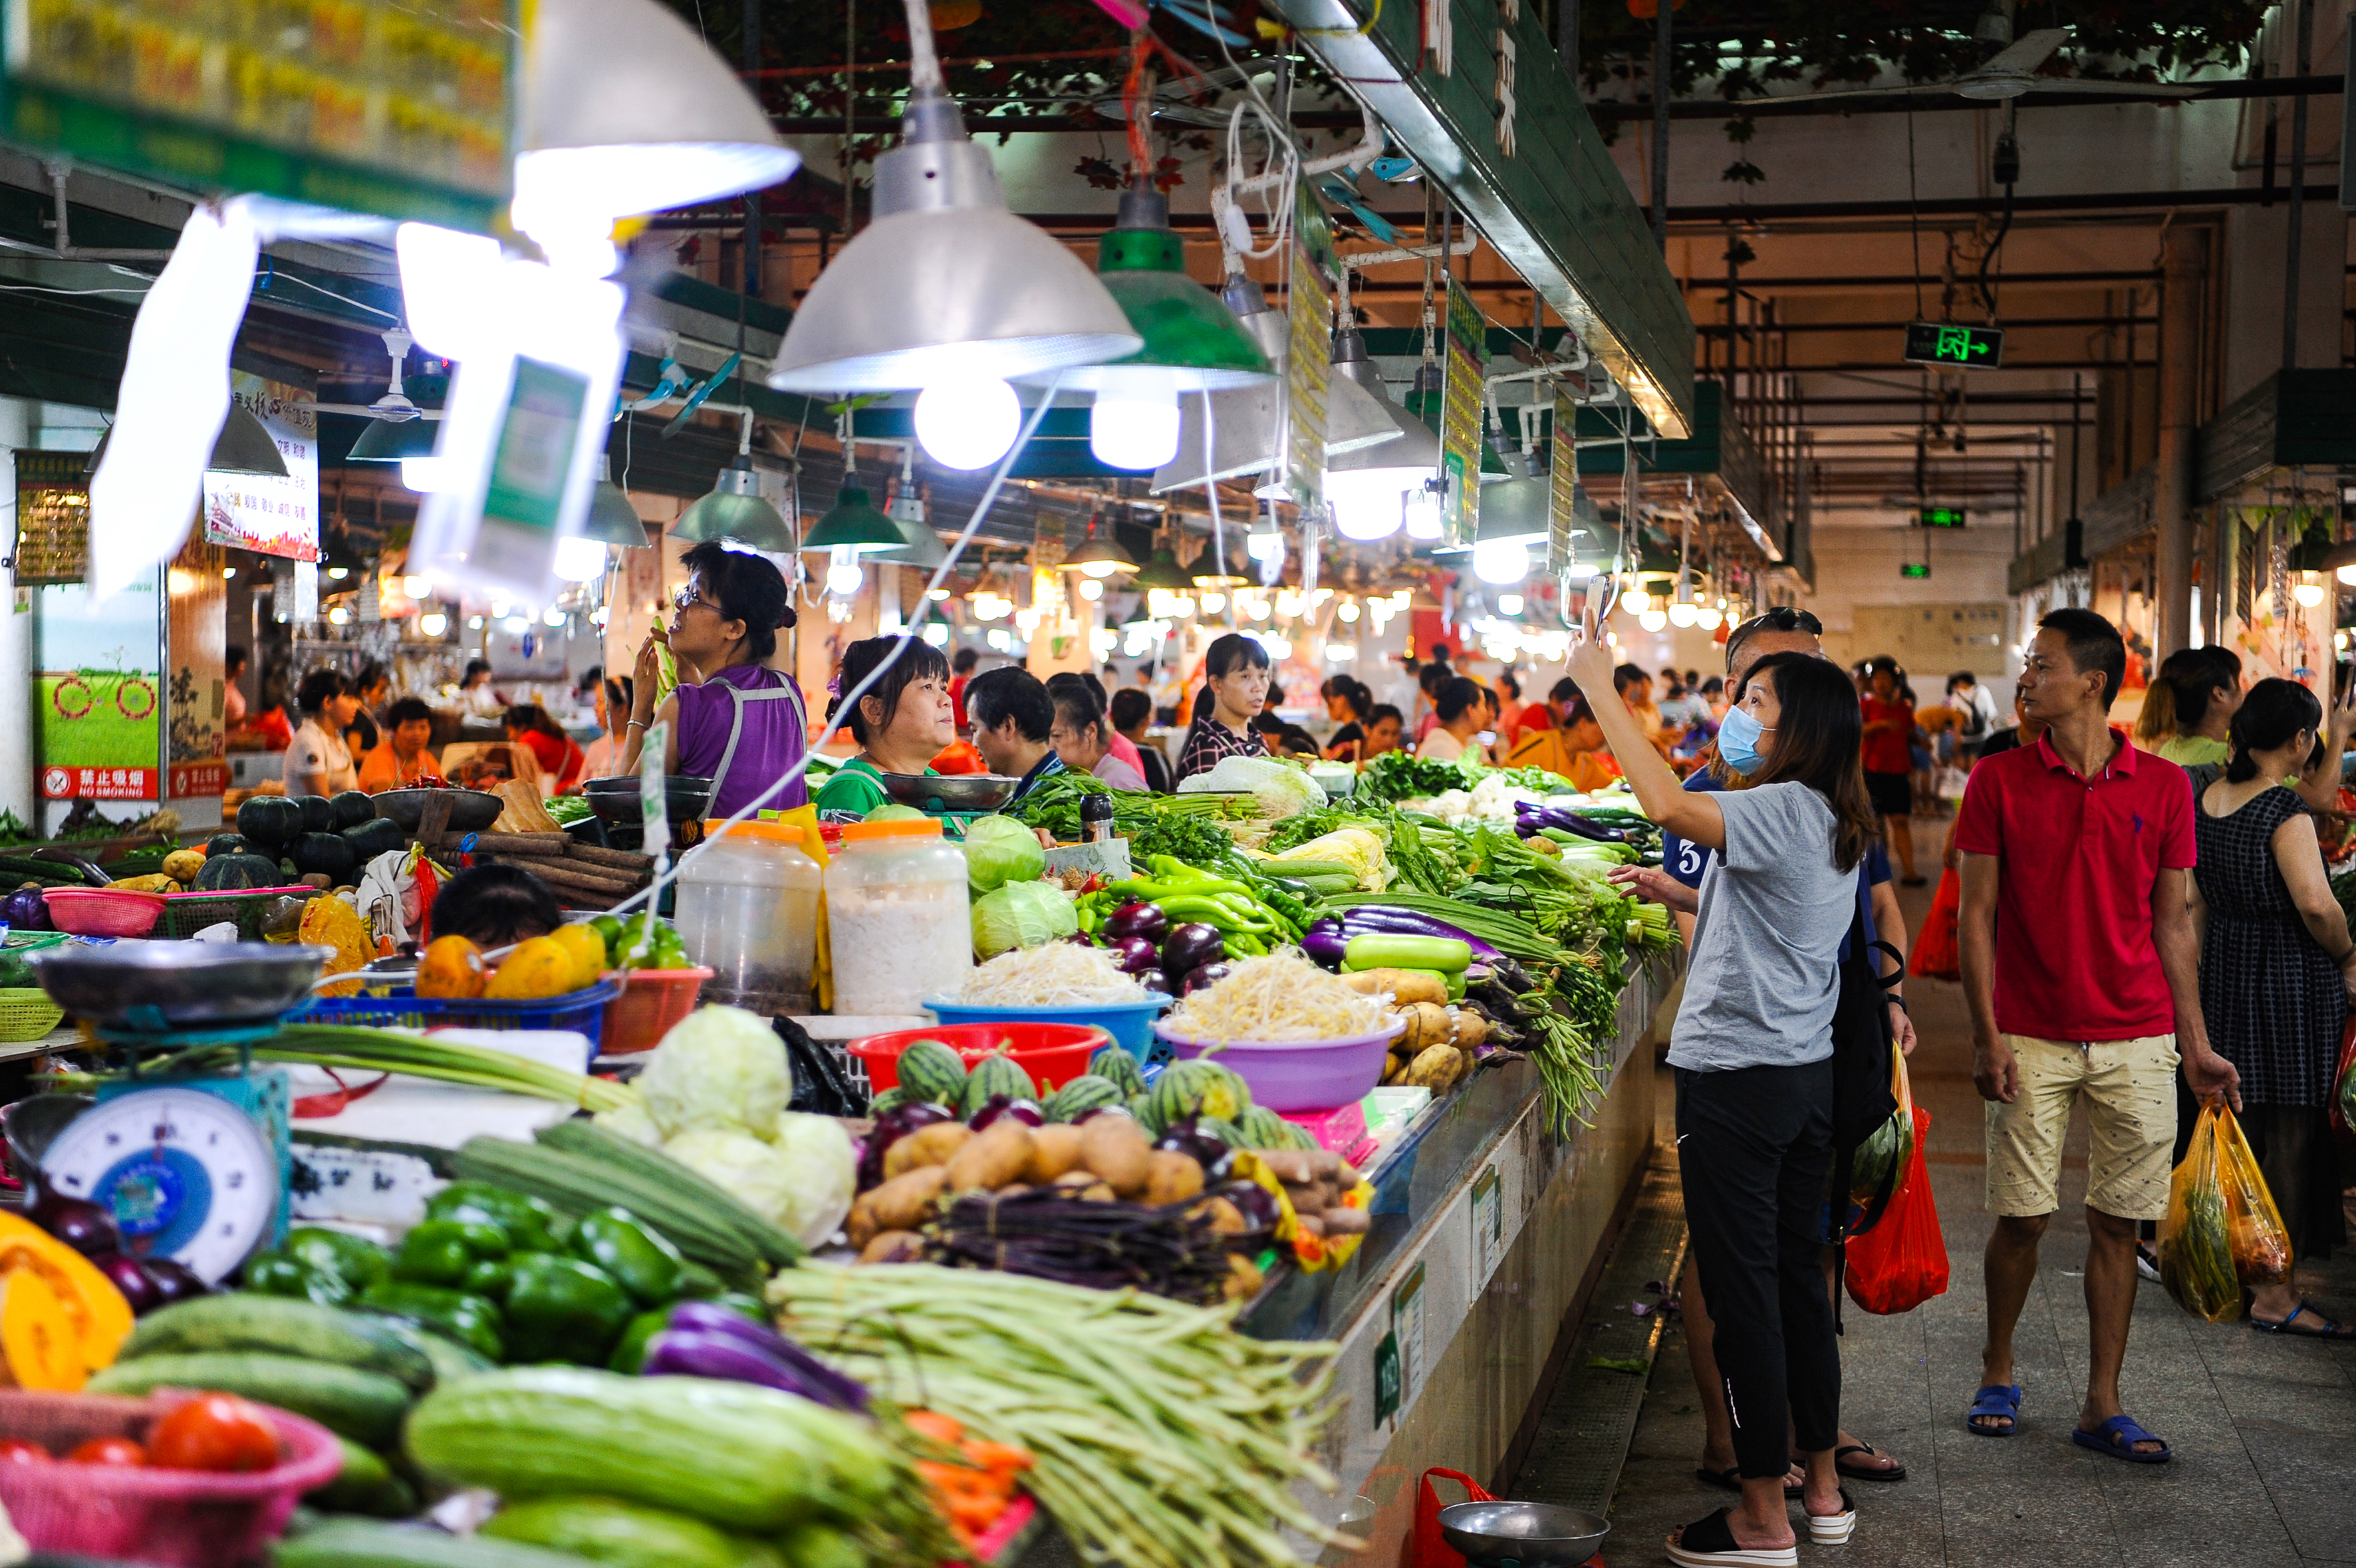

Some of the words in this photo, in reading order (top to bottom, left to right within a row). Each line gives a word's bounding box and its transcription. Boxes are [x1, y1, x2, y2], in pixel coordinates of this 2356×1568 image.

[80, 769, 144, 787] 禁止吸烟
[79, 786, 94, 797] NO
[96, 786, 144, 798] SMOKING
[1679, 839, 1701, 874] 3
